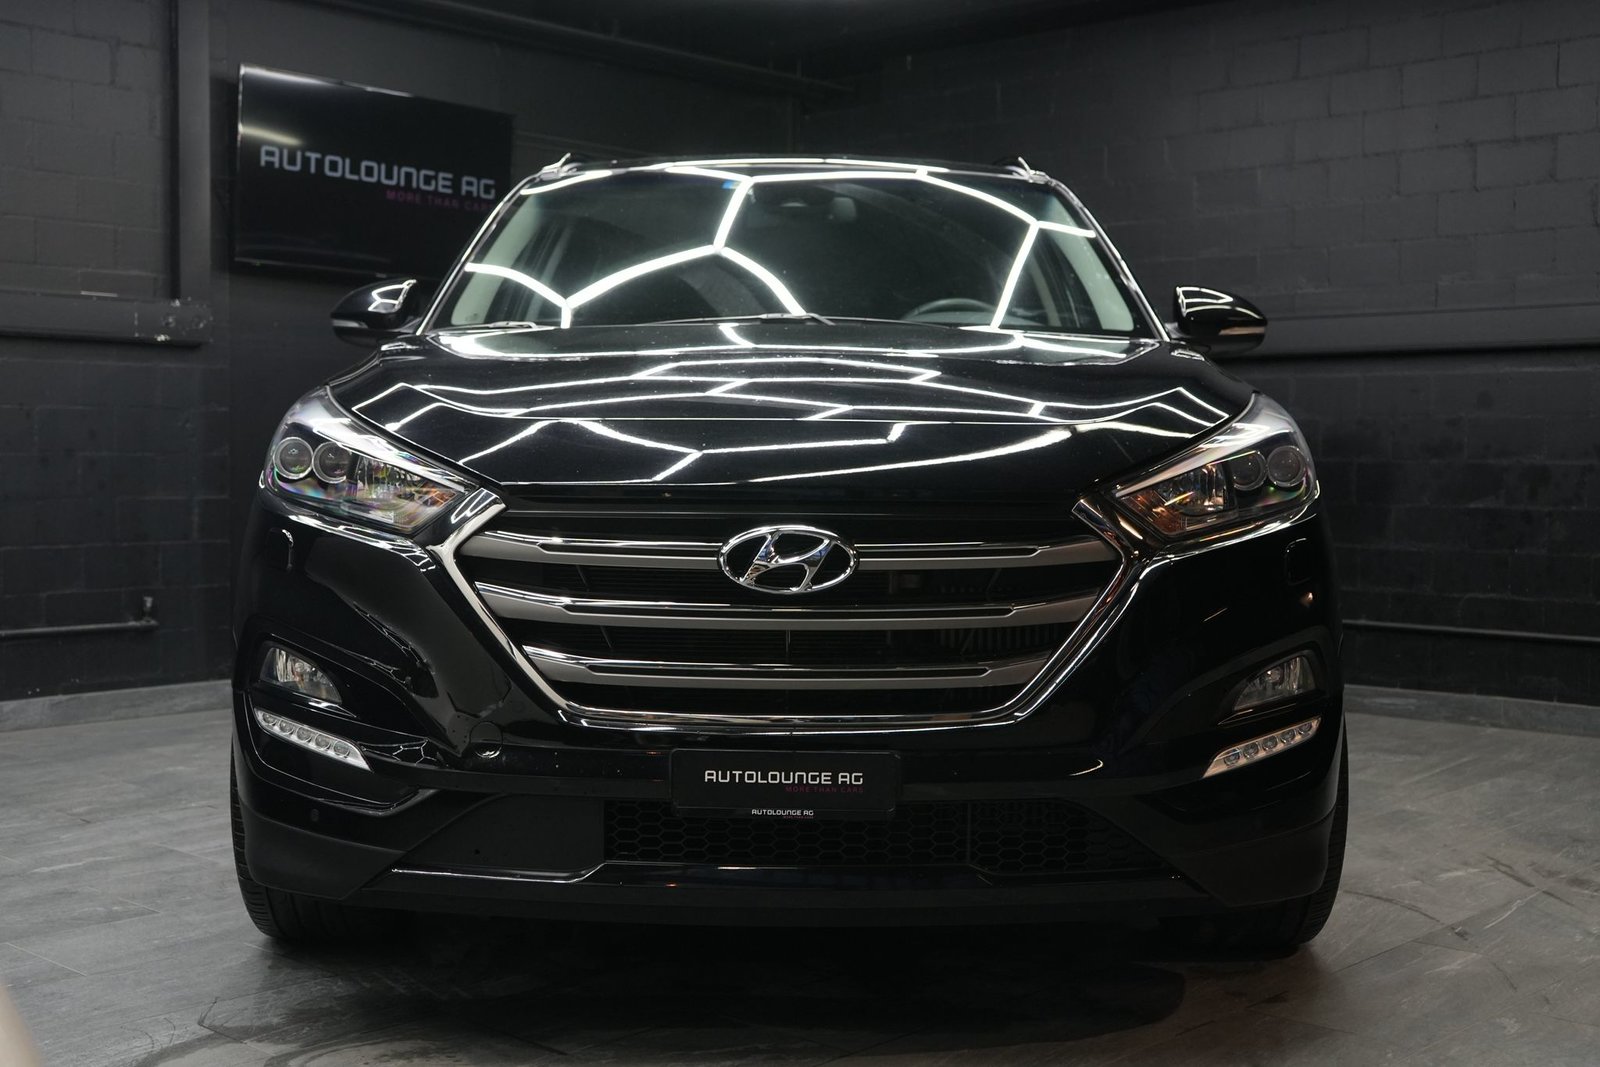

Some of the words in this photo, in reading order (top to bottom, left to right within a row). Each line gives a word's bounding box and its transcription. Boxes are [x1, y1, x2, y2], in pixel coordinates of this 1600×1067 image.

[260, 145, 453, 193] AUTOLOUNGE
[461, 176, 496, 199] AG
[385, 189, 422, 204] MORE
[427, 193, 460, 209] THAN
[464, 200, 494, 213] CAR
[704, 770, 832, 785] AUTOLOUNGE
[838, 772, 864, 786] AG
[784, 785, 812, 793] MORE
